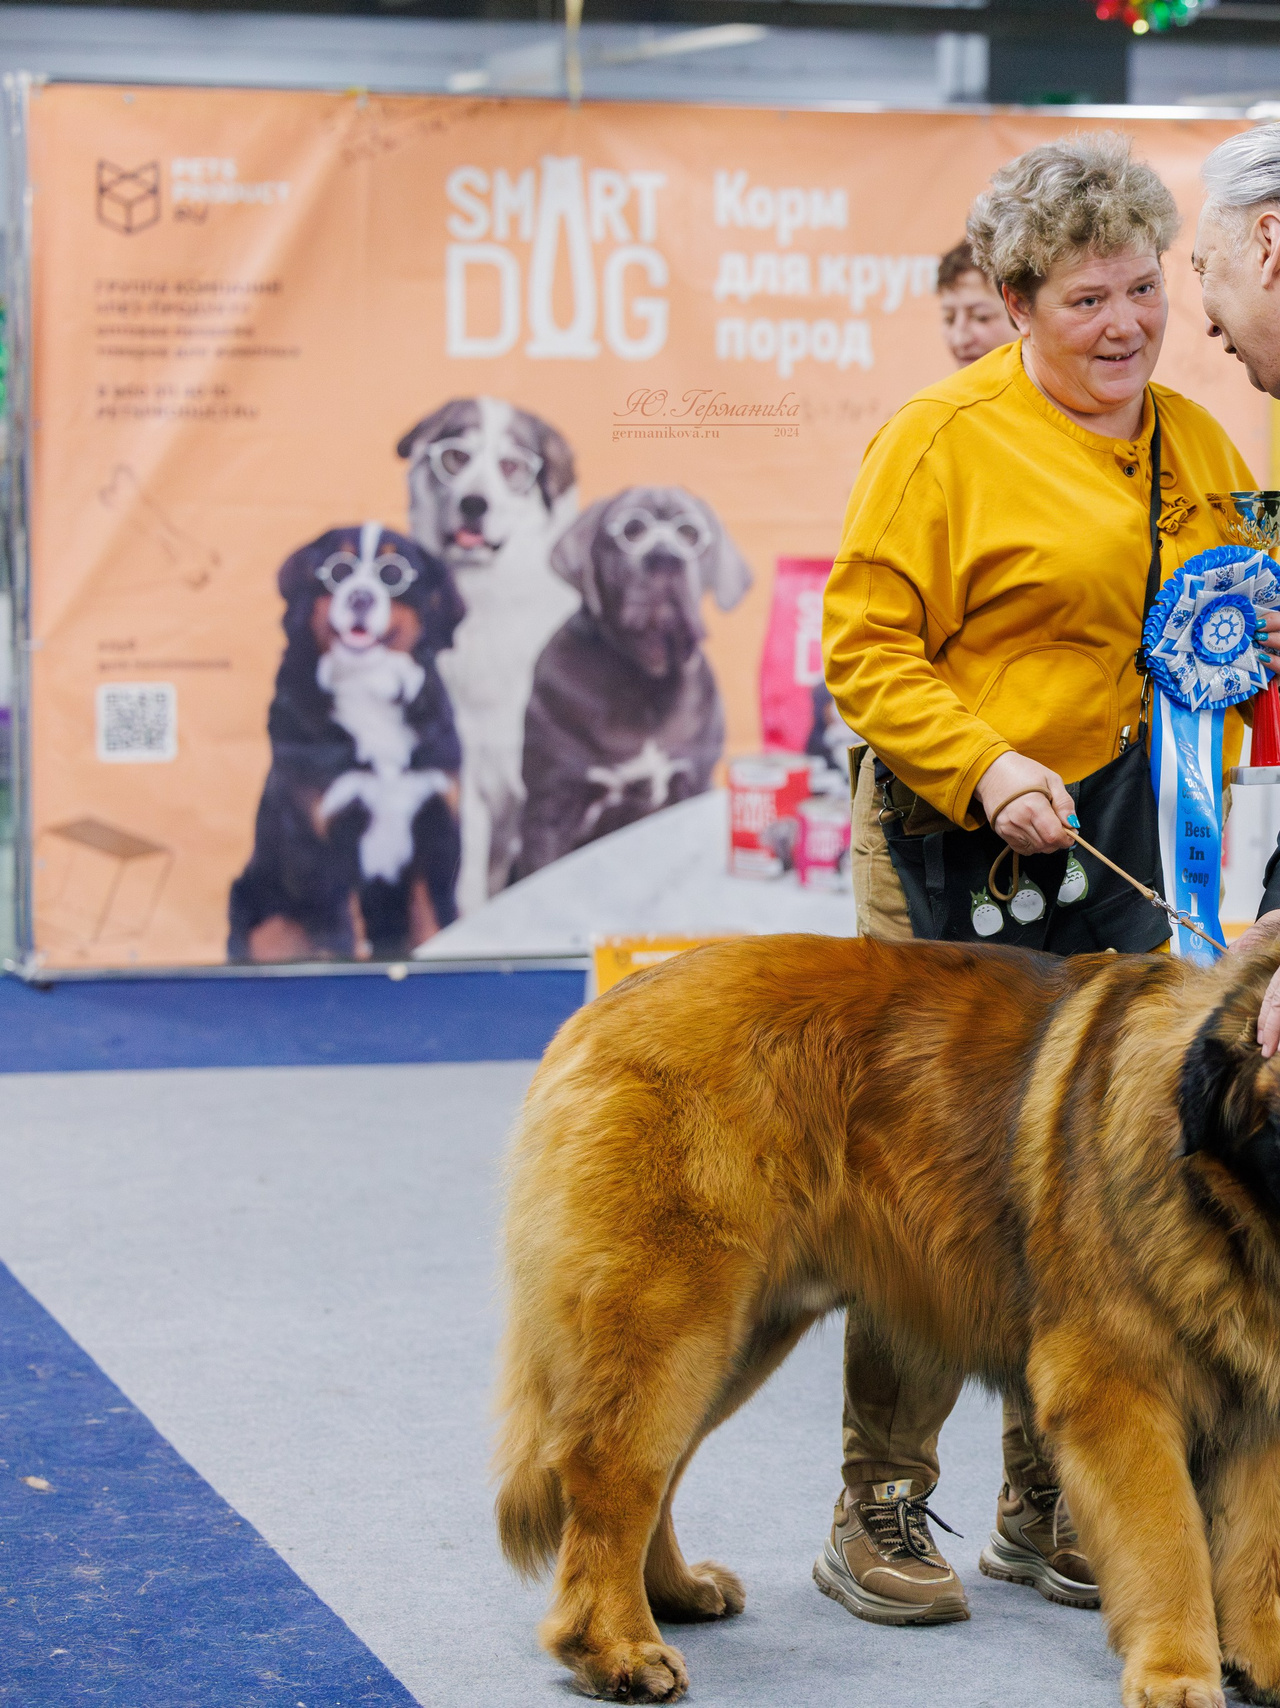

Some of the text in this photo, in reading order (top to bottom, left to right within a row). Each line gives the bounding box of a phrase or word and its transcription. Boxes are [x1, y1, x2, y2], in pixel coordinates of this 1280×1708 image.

[445, 156, 667, 242] SMART
[714, 169, 847, 245] Корм
[445, 244, 669, 361] DOG
[714, 252, 940, 314] для круп
[715, 317, 873, 379] пород
[1185, 821, 1211, 838] Best
[1189, 846, 1205, 860] In
[1182, 868, 1209, 887] Group
[1188, 892, 1200, 917] 1
